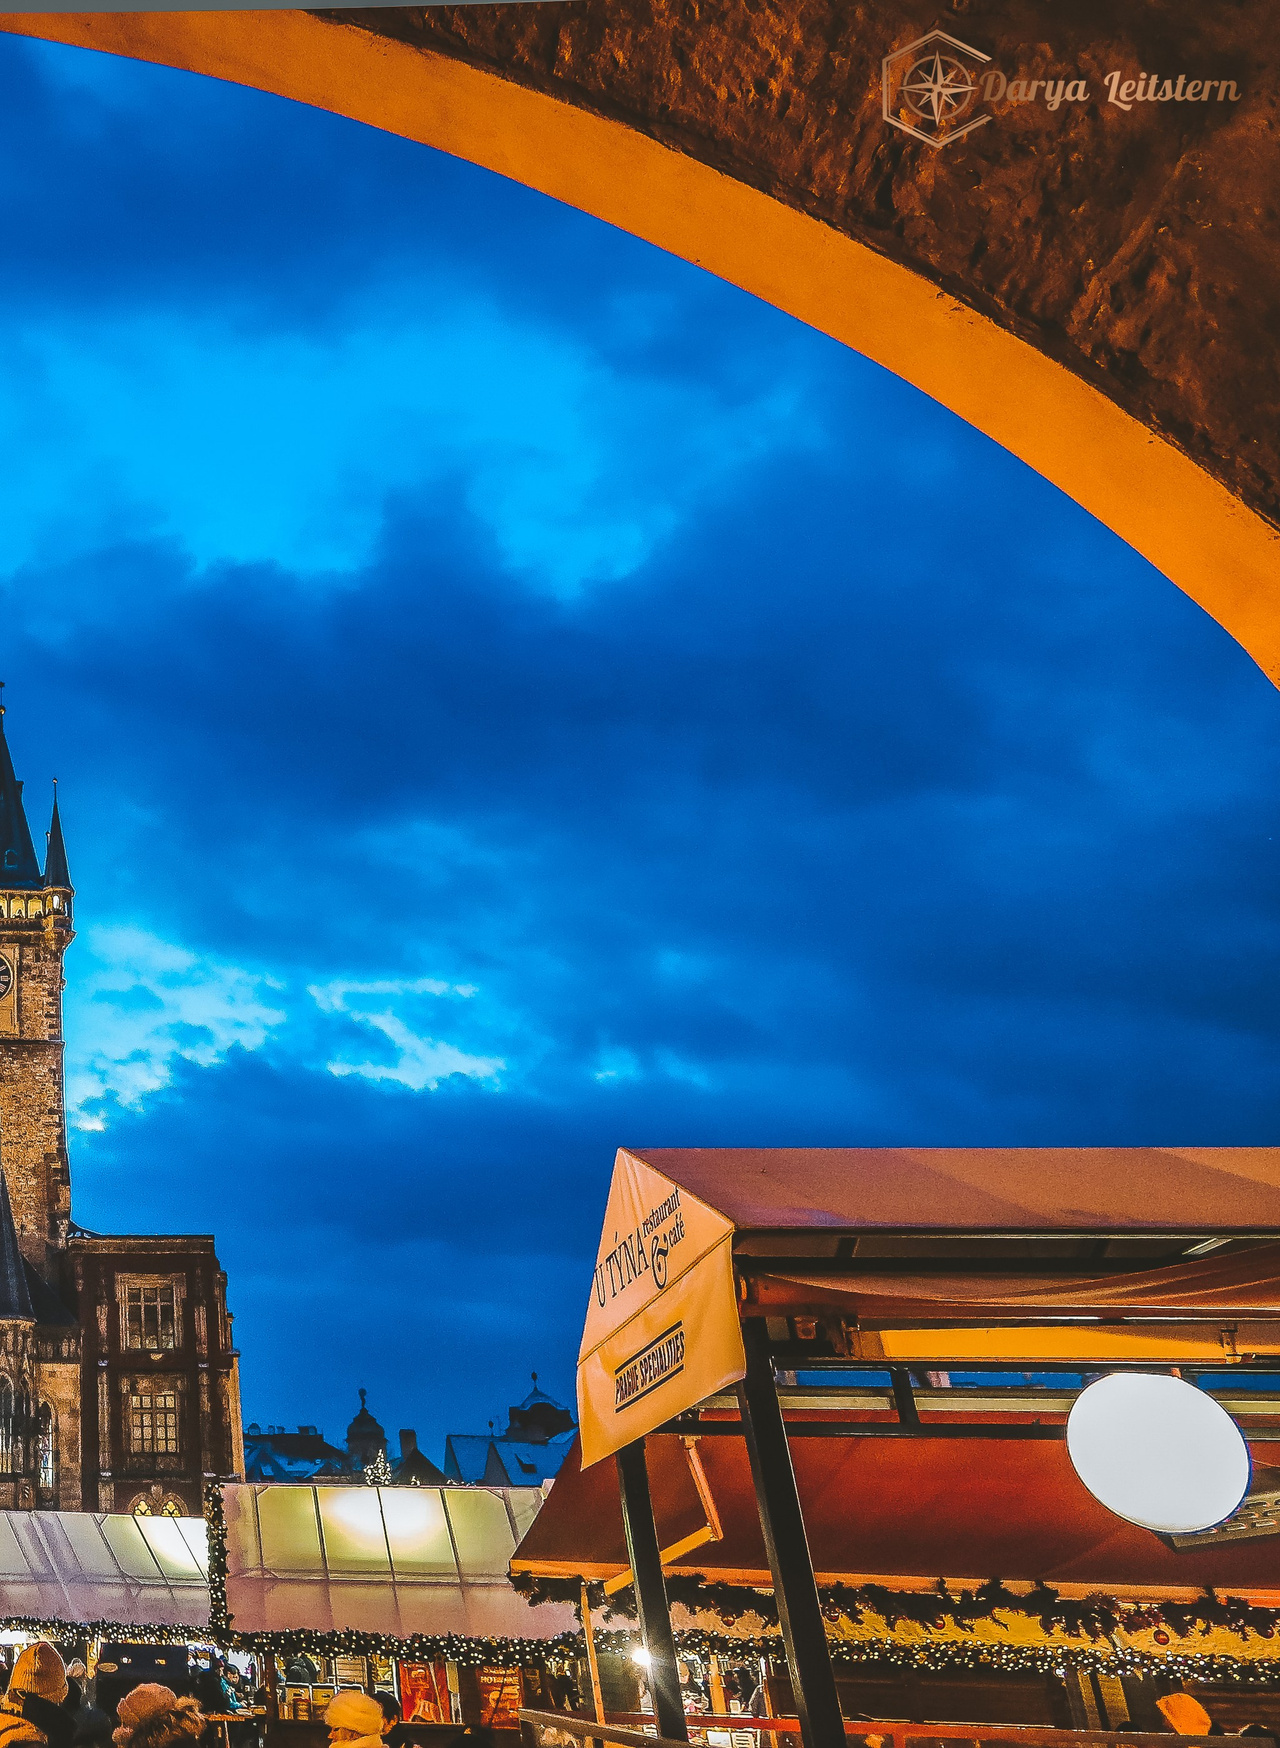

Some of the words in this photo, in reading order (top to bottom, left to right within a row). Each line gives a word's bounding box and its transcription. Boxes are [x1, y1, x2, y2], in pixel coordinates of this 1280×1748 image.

[642, 1185, 681, 1238] restaurant
[594, 1263, 606, 1307] U
[605, 1227, 650, 1298] TÝNA
[668, 1212, 685, 1248] café
[615, 1364, 639, 1405] PRAGUE
